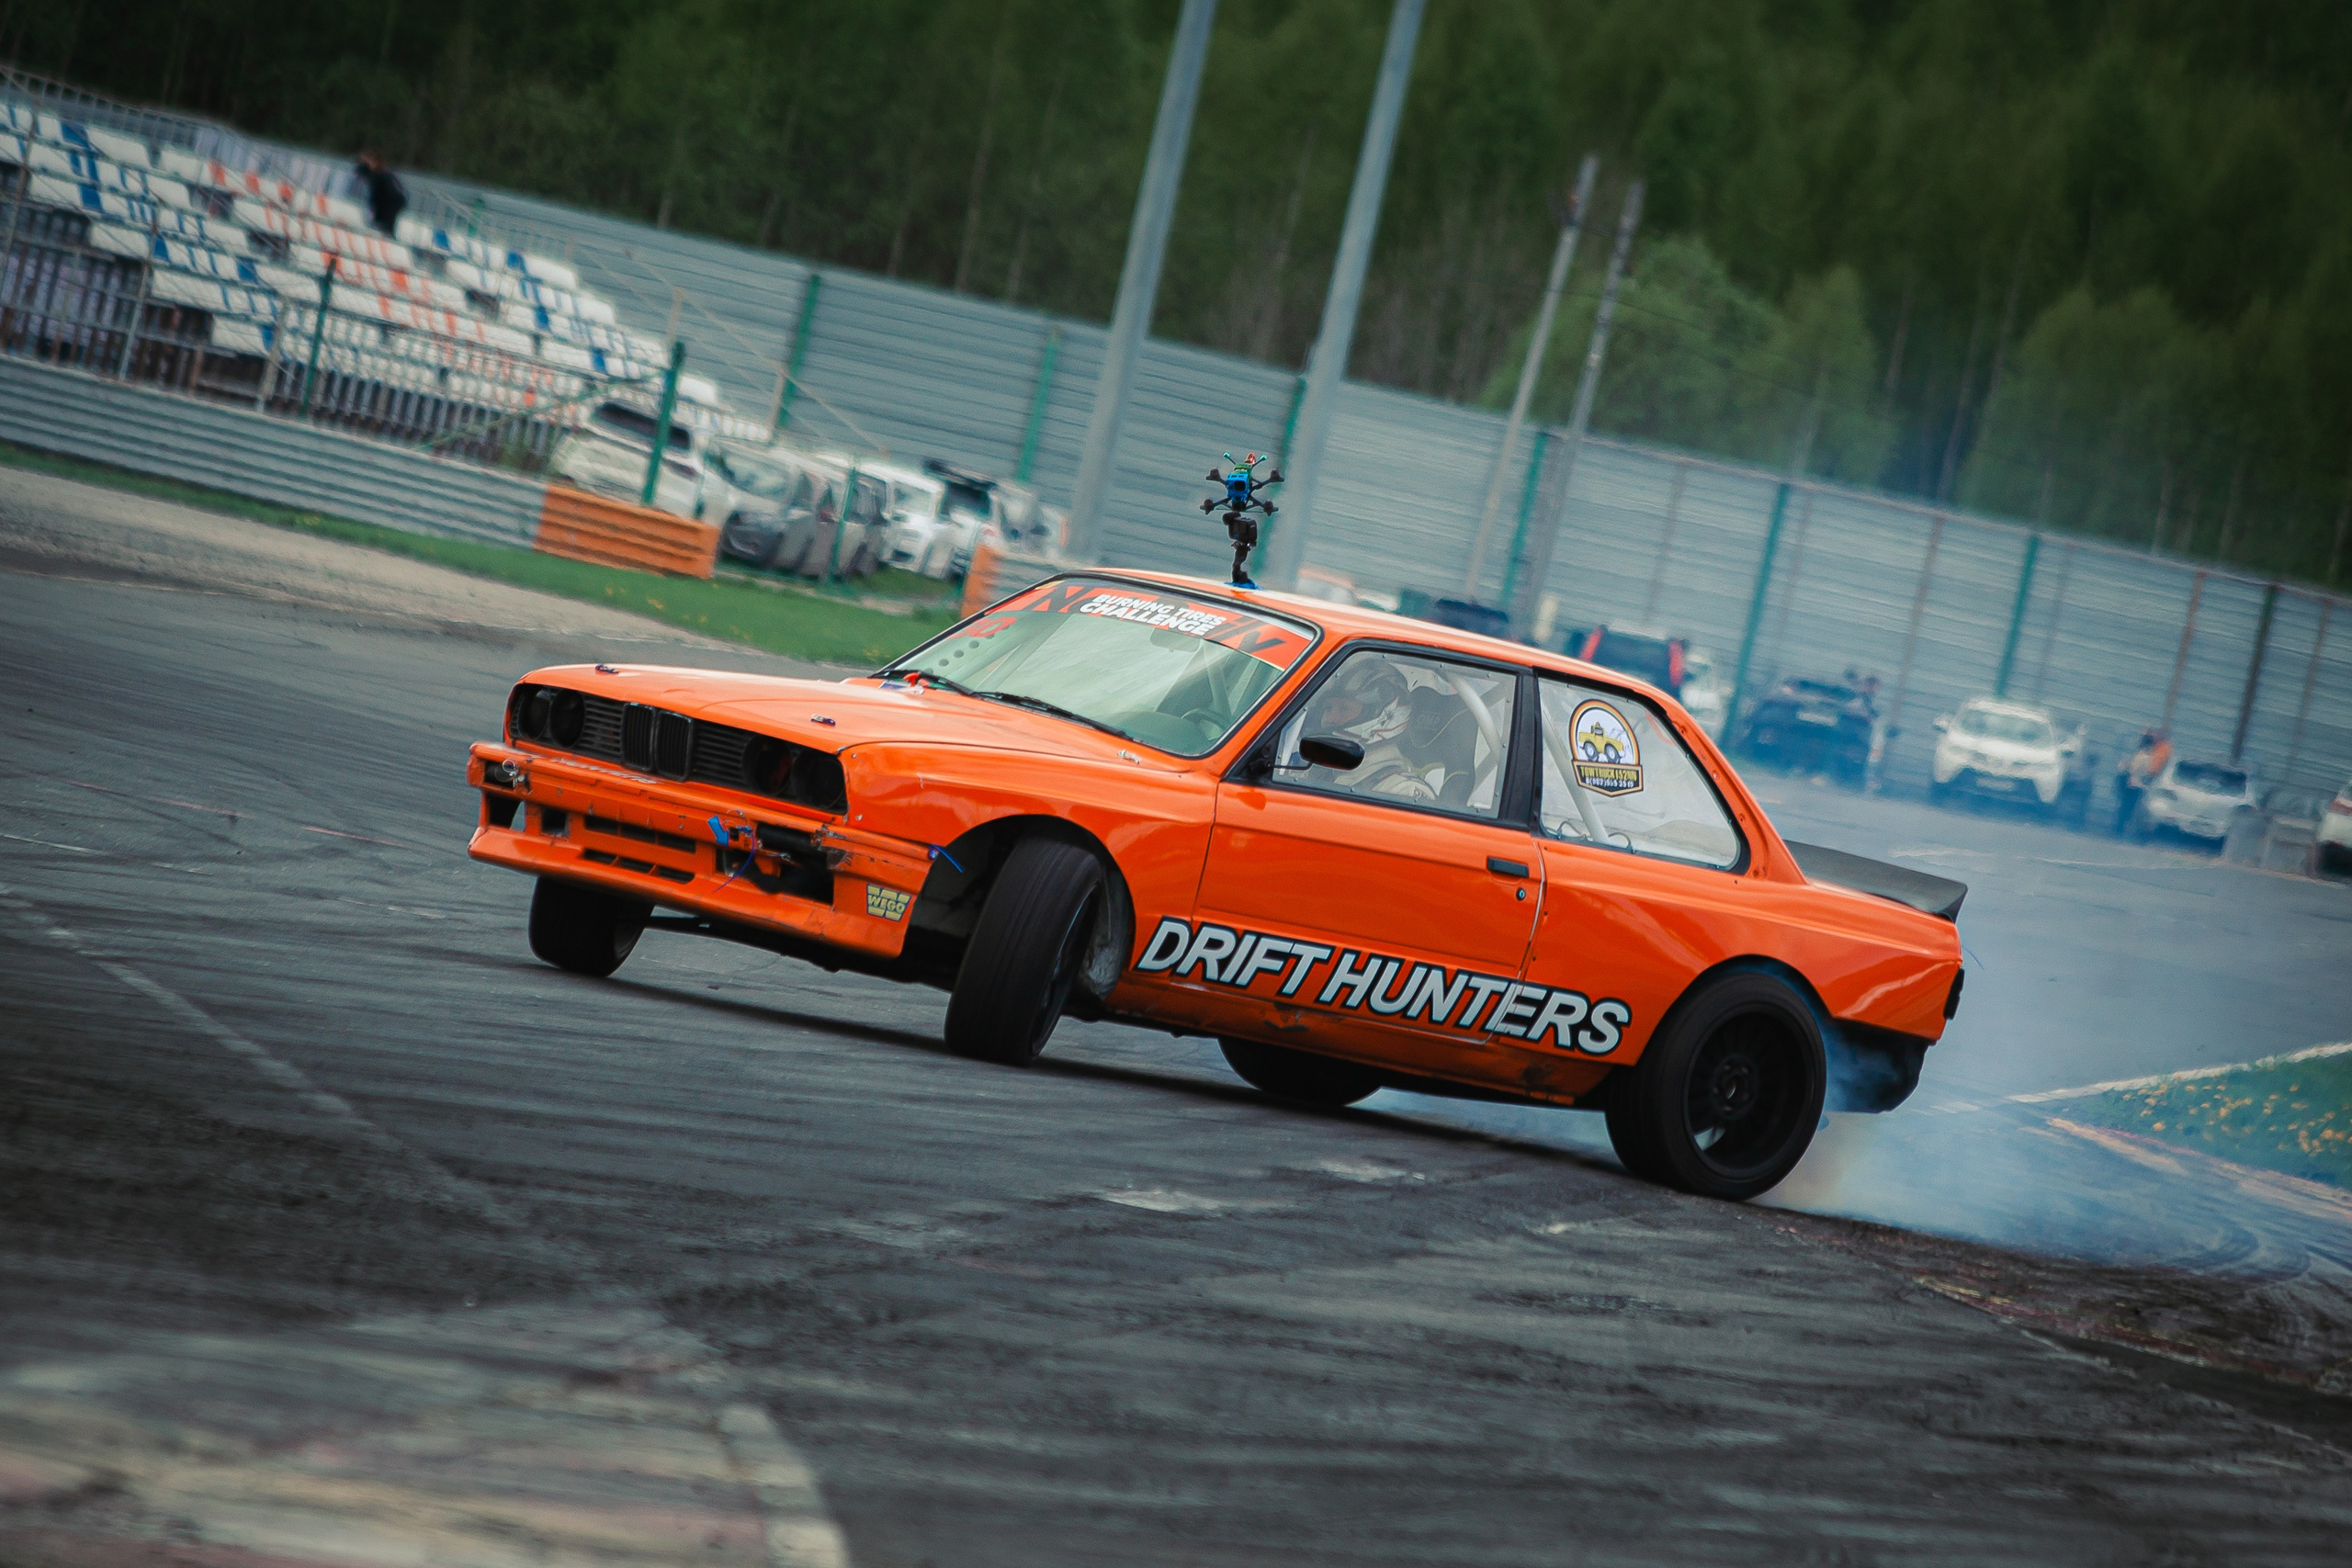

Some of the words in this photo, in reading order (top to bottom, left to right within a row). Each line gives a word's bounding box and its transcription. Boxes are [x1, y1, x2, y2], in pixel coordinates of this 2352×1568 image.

[1080, 603, 1216, 637] CHALLENGE
[1091, 593, 1176, 615] BURNING
[1175, 607, 1227, 626] TIRES
[867, 895, 906, 914] WEGO
[1136, 919, 1332, 995] DRIFT
[1317, 952, 1632, 1055] HUNTERS
